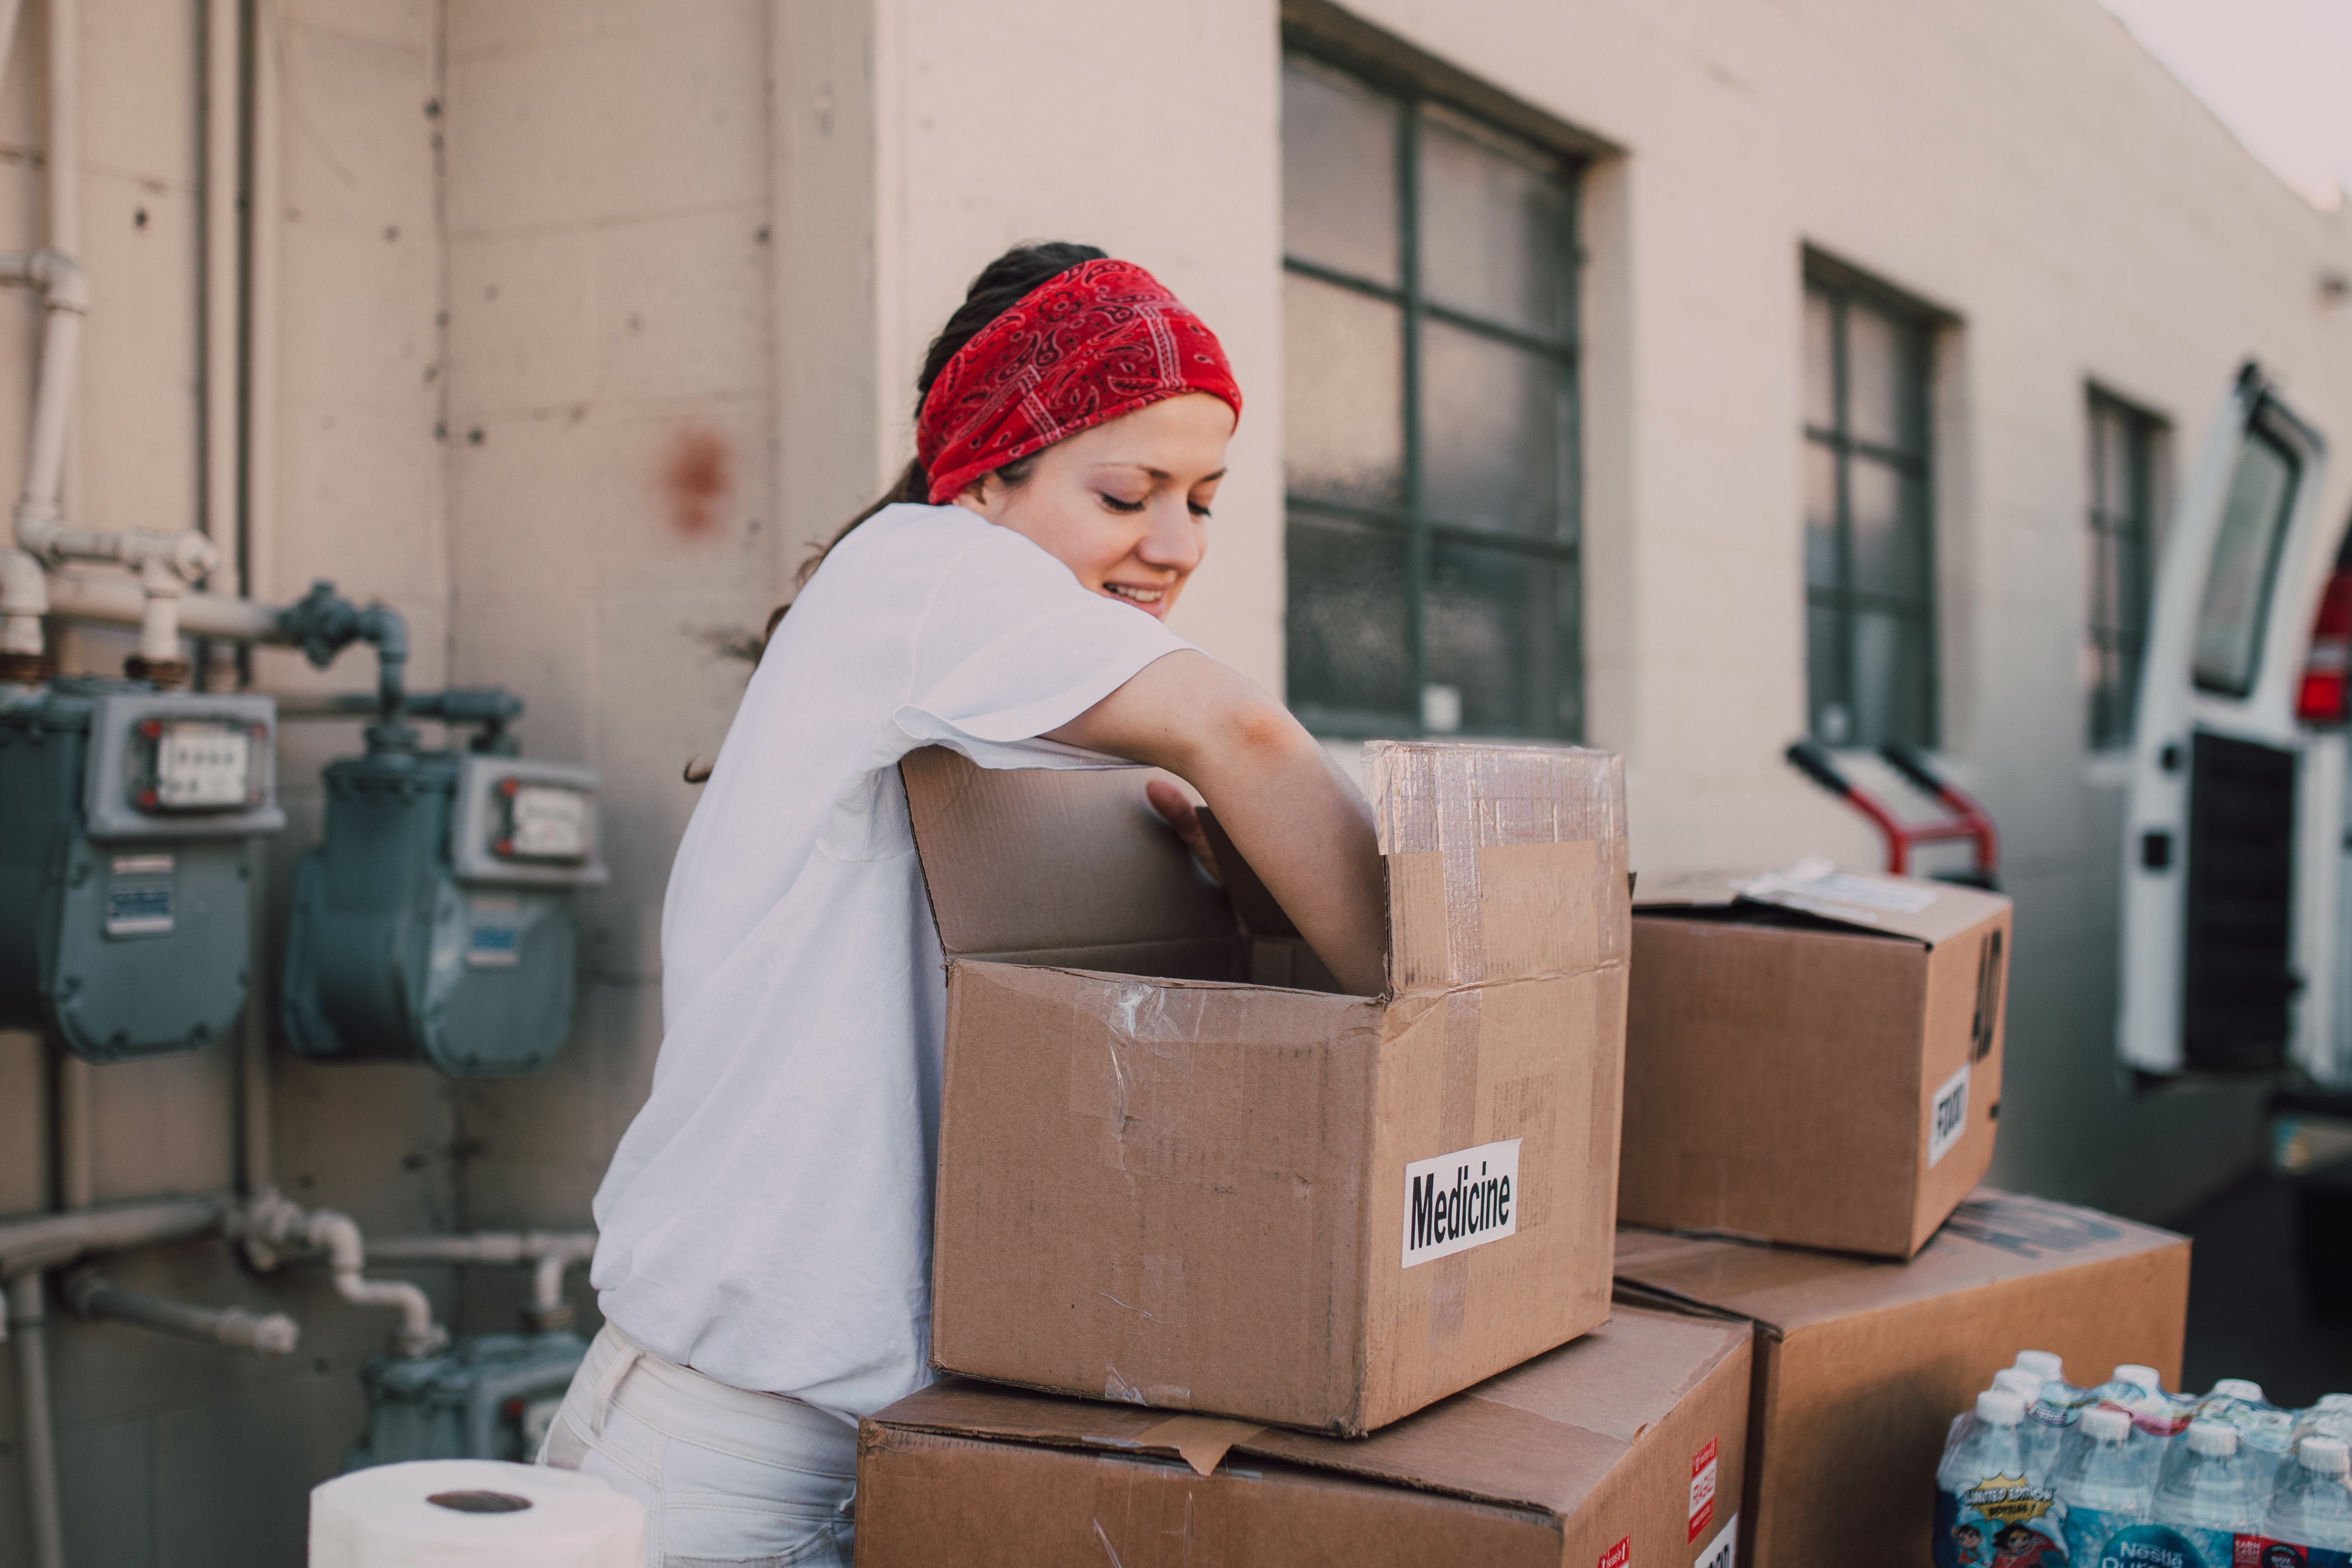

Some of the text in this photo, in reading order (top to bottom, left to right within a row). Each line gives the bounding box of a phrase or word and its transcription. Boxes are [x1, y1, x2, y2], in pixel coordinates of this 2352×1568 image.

[1410, 1161, 1510, 1251] Medicine
[1965, 1486, 2054, 1505] LIMITED EDITION
[2235, 1540, 2260, 1549] EARN
